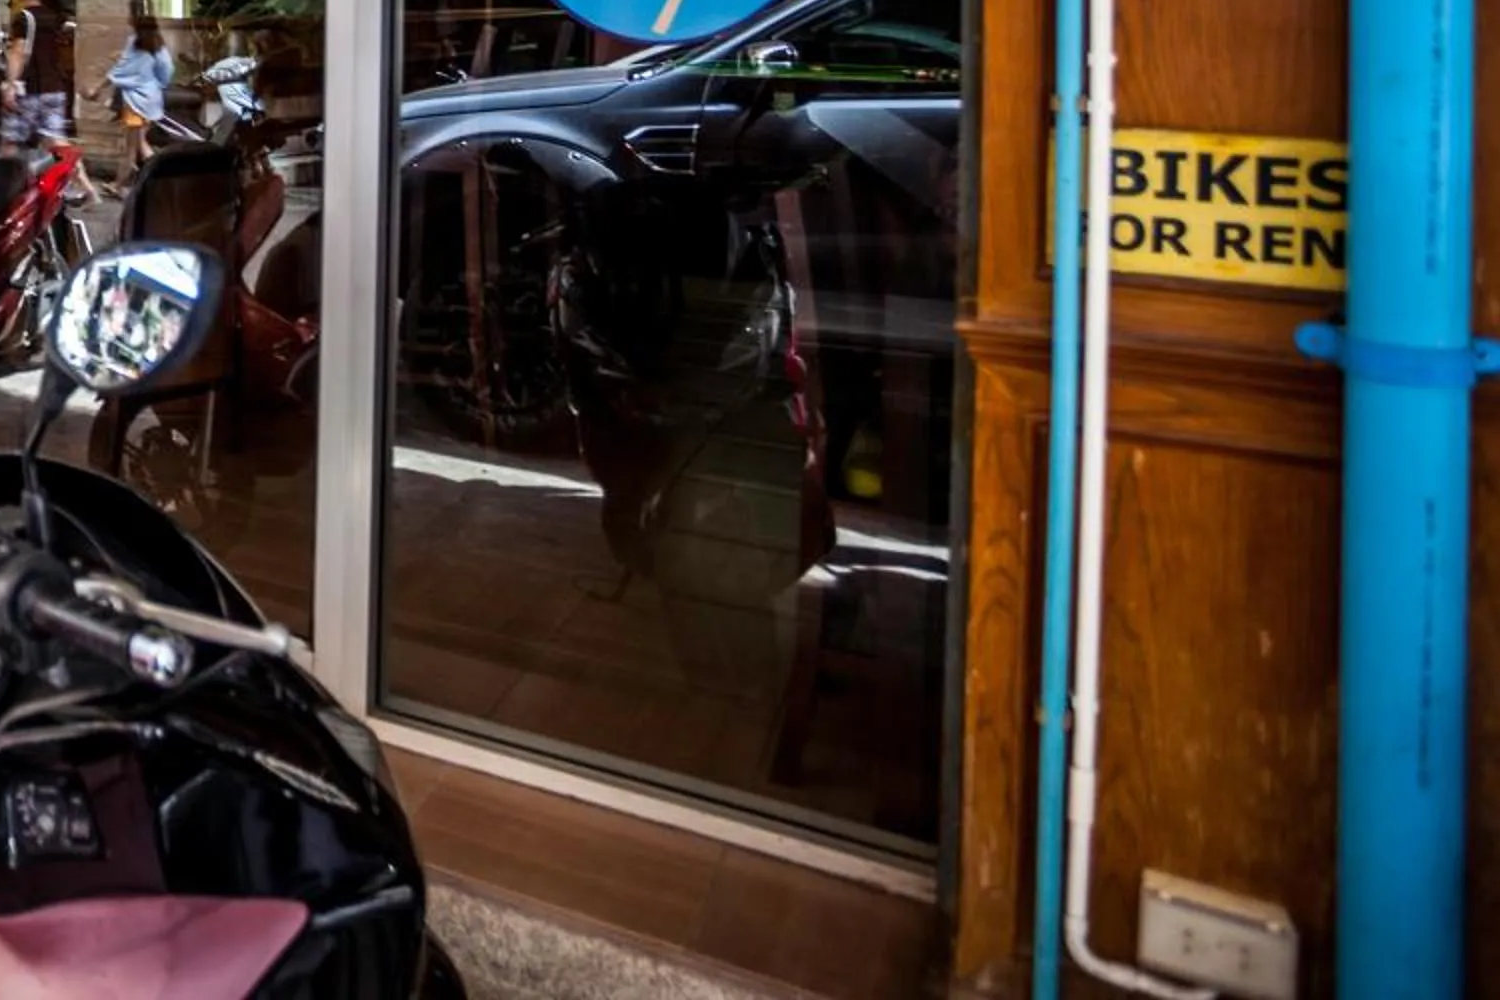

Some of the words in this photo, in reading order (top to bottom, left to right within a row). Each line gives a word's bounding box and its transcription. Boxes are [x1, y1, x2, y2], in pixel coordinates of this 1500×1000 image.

[1109, 147, 1350, 214] BIKES
[1079, 210, 1191, 257] OR
[1214, 220, 1347, 270] REN
